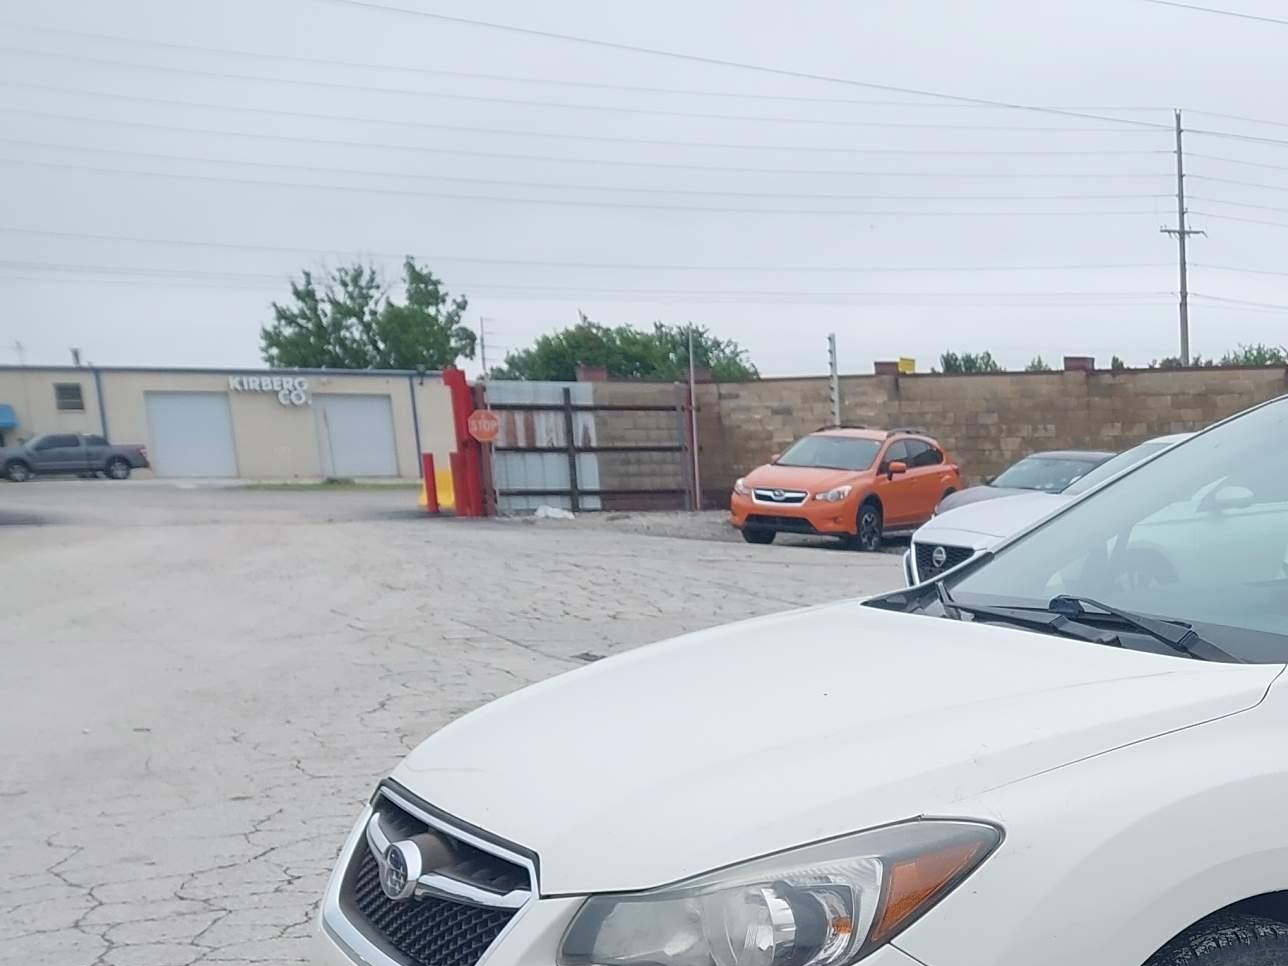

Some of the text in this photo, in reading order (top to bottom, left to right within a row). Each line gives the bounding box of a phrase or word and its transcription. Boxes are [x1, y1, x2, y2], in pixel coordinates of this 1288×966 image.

[228, 376, 309, 392] KIRBERG
[278, 389, 312, 406] CO.
[469, 420, 497, 433] STOP
